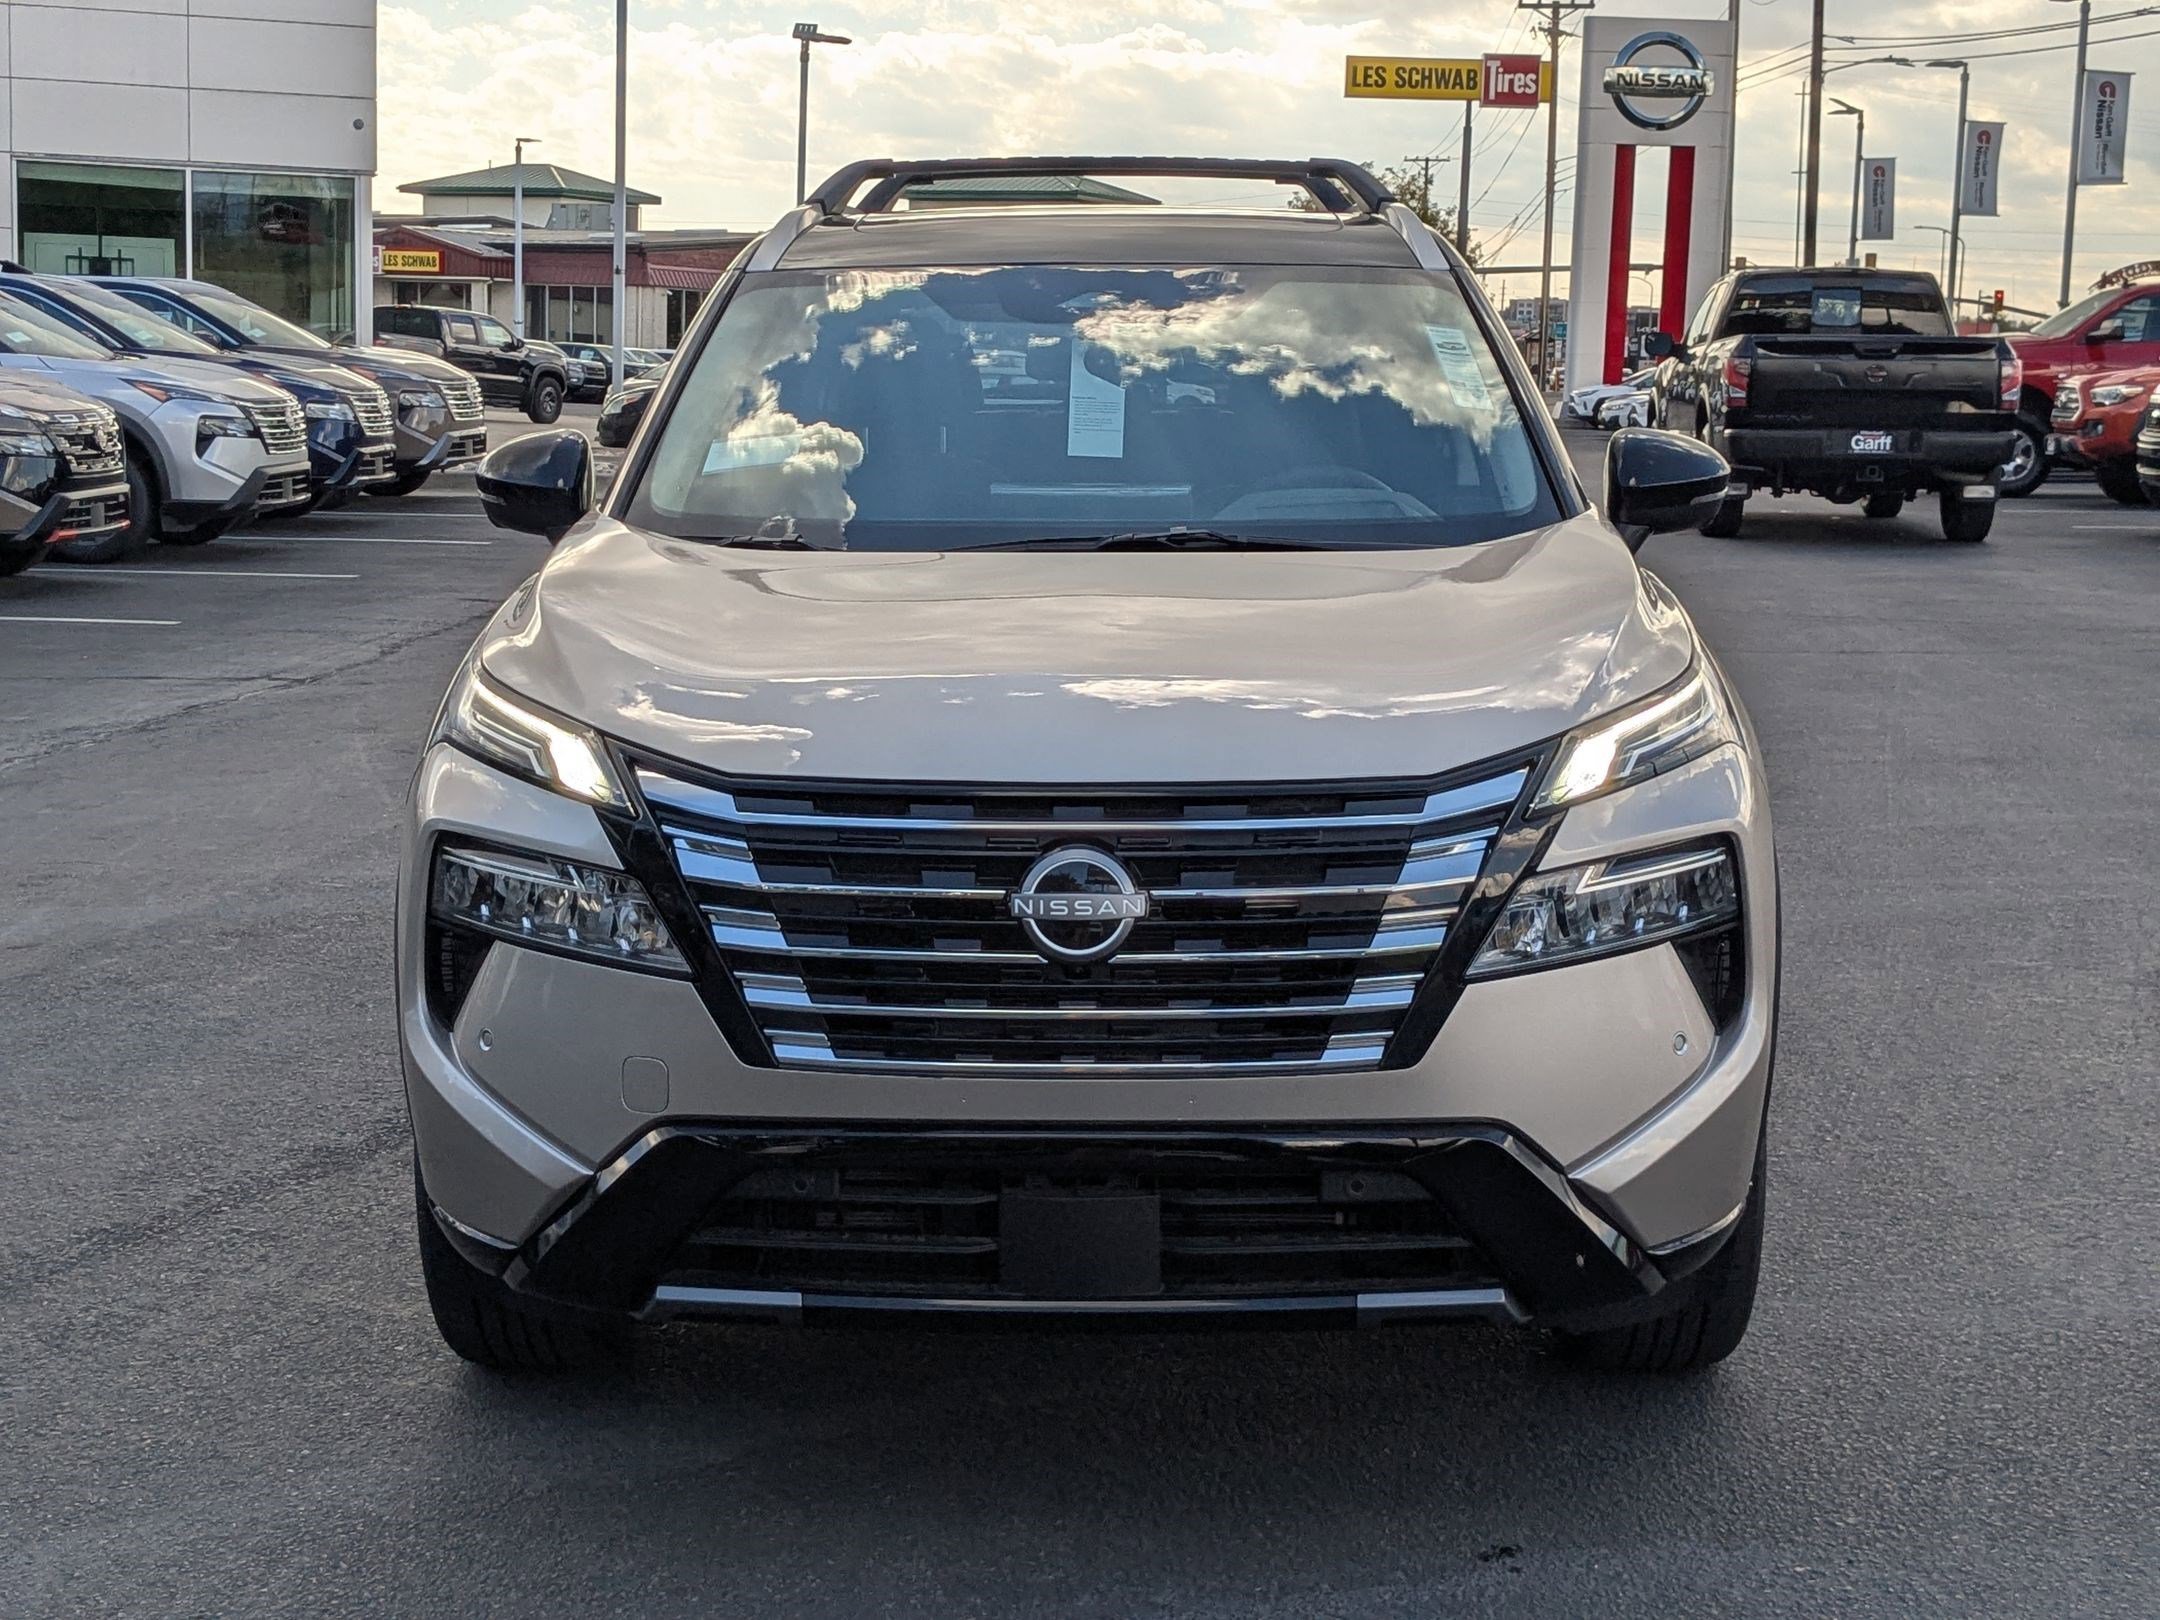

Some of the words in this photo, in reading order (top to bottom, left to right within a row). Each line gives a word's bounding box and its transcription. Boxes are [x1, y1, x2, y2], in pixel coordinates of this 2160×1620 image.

[1352, 64, 1387, 88] LES
[1395, 66, 1478, 91] SCHWAB
[1486, 60, 1537, 101] Tires
[1616, 73, 1706, 91] NISSAN
[2095, 100, 2108, 139] Nissan
[383, 254, 399, 267] LES
[401, 255, 437, 268] SCHWAB
[1850, 435, 1893, 450] Garff
[1014, 898, 1142, 916] NISSAN
